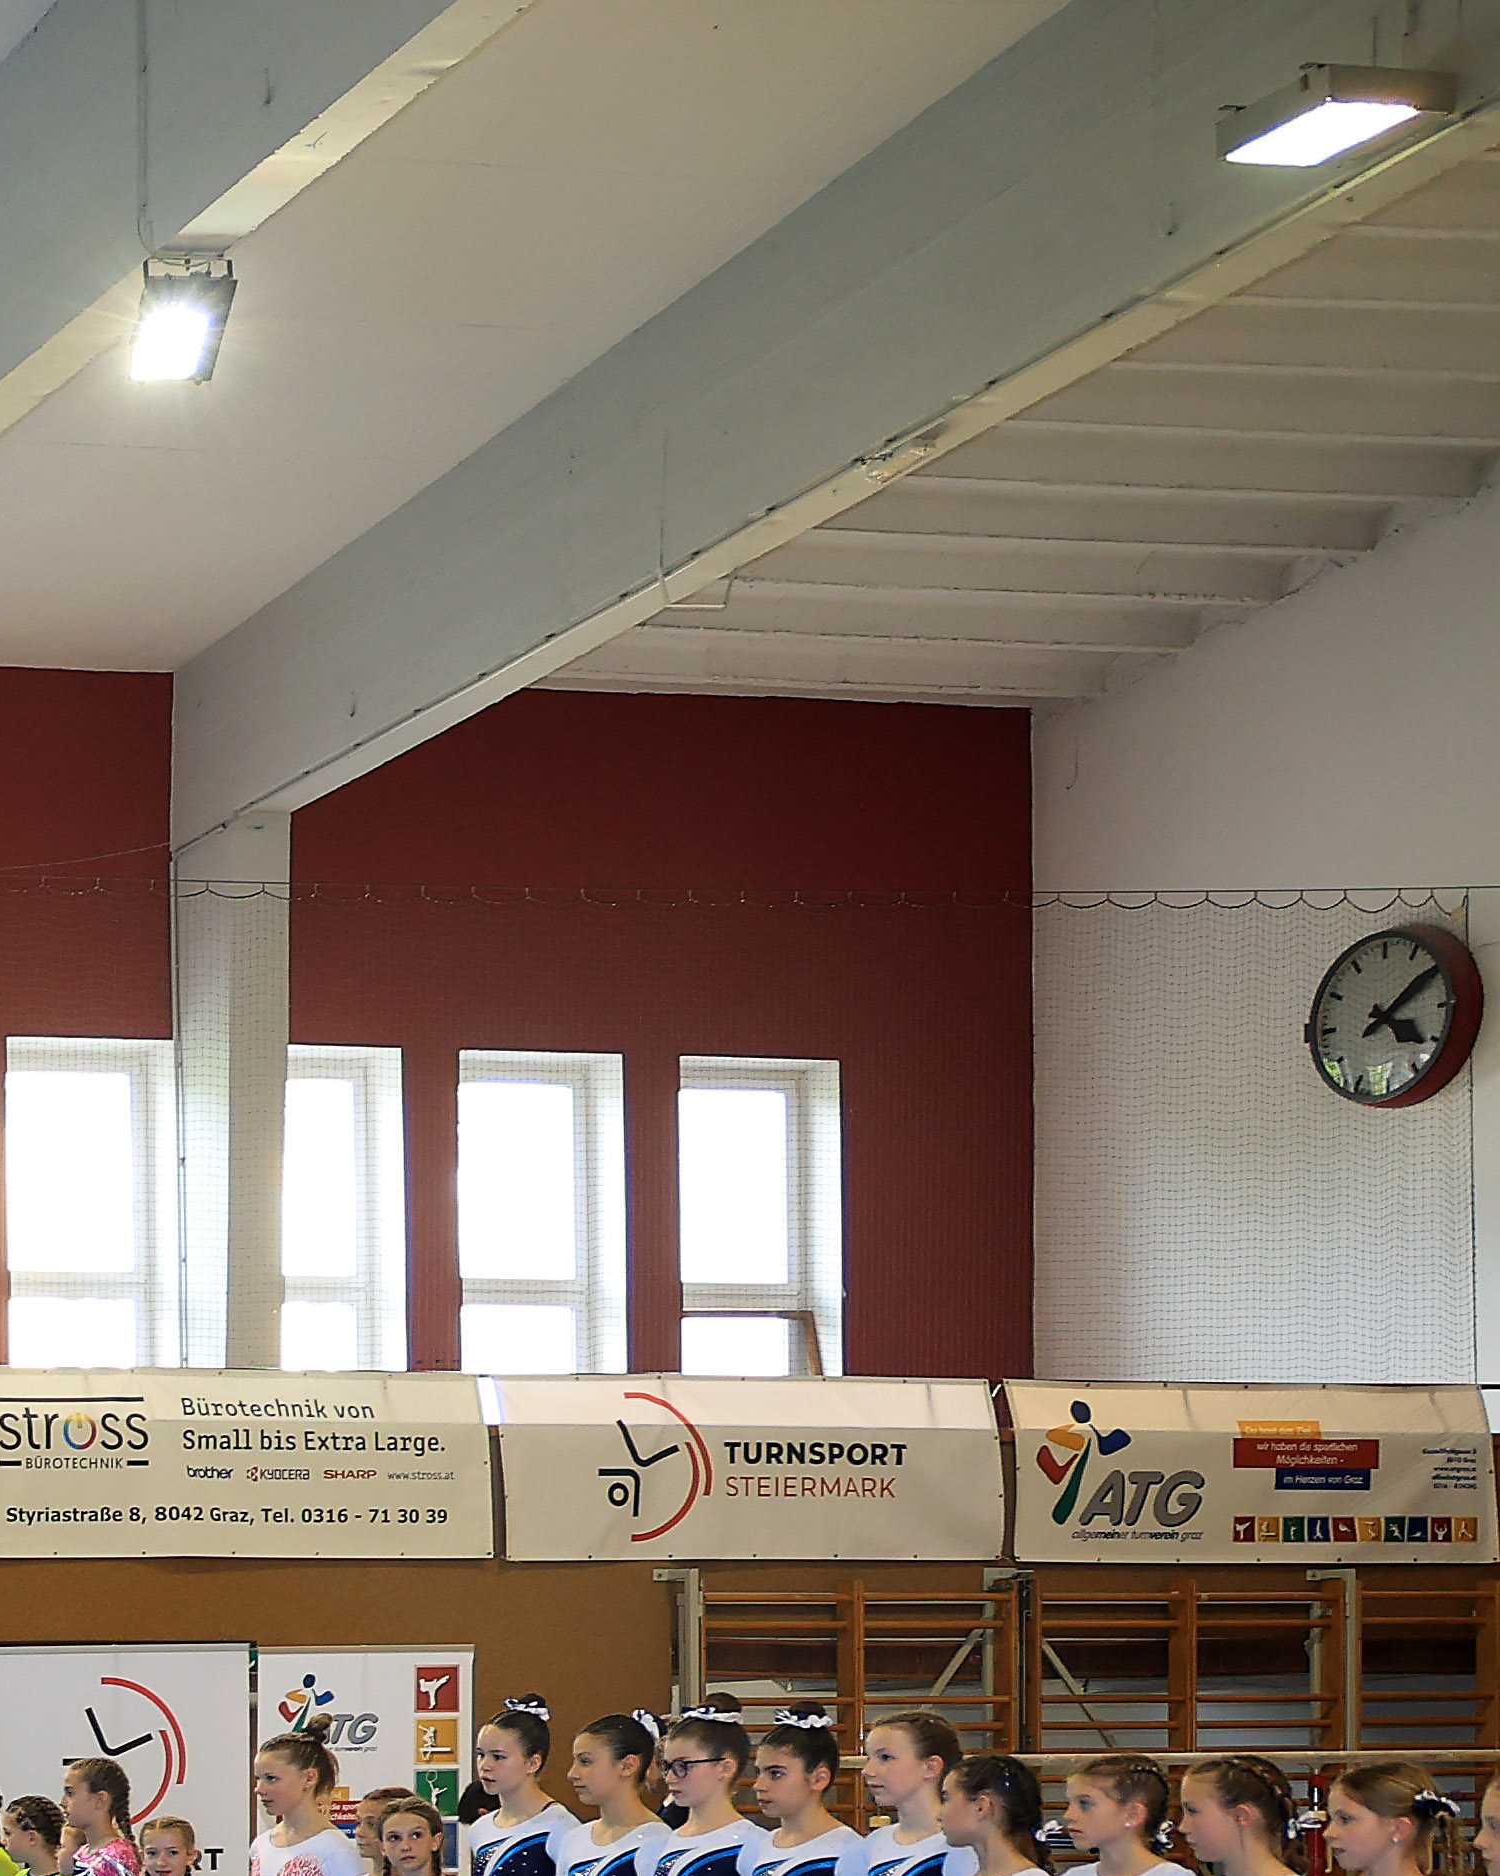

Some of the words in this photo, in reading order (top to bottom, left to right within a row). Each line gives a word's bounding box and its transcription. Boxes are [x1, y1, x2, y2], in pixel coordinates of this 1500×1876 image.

[180, 1397, 327, 1419] Bürotechnik
[334, 1403, 375, 1419] von
[182, 1429, 253, 1451] Small
[261, 1430, 296, 1451] bis
[304, 1430, 366, 1451] Extra
[375, 1431, 446, 1457] Large.
[724, 1441, 907, 1466] TURNSPORT
[25, 1455, 124, 1469] BÜROTECHNIK
[187, 1465, 234, 1479] brother
[323, 1469, 377, 1479] SHARP
[387, 1470, 455, 1481] www.stross.at
[726, 1476, 897, 1498] STEIERMARK
[1079, 1469, 1205, 1527] ATG
[6, 1506, 123, 1526] Styriastraße
[129, 1506, 147, 1525] 8,
[155, 1506, 204, 1521] 8042
[210, 1507, 254, 1525] Graz,
[261, 1507, 295, 1523] Tel.
[301, 1508, 348, 1523] 0316
[369, 1508, 390, 1523] 71
[397, 1508, 419, 1523] 30
[426, 1508, 448, 1524] 39
[324, 1713, 379, 1745] TG
